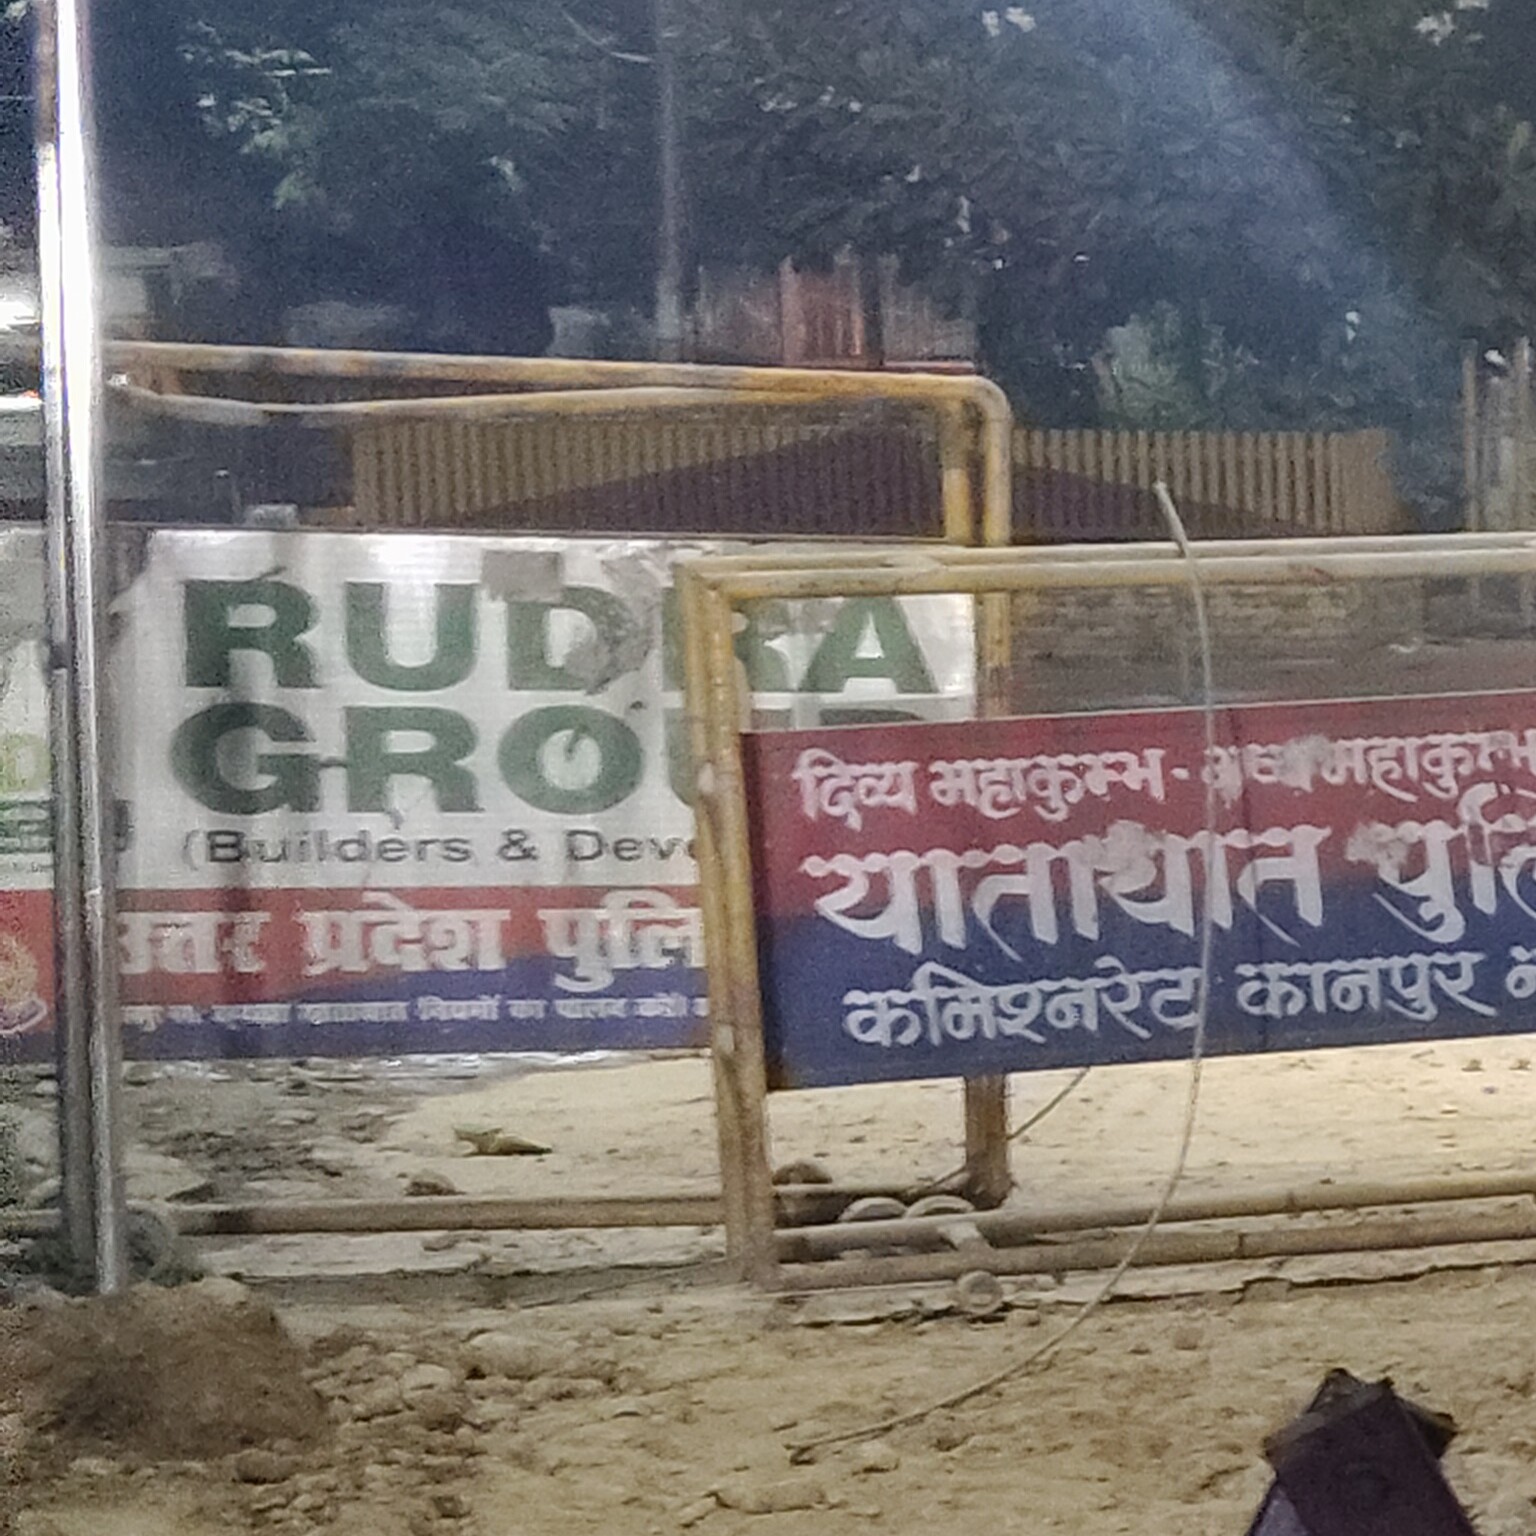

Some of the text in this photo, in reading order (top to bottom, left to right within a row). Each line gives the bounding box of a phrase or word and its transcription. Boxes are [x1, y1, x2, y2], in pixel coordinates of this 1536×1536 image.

[170, 701, 703, 816] GRO
[792, 748, 919, 832] दिव्य
[928, 748, 1166, 822] महाकुम्भ
[498, 829, 539, 860] &
[800, 820, 1332, 962] यातायात
[292, 891, 511, 977] प्रदेश
[536, 889, 706, 993] पुलि
[842, 955, 1205, 1048] कमिश्नरेट
[1234, 950, 1498, 1024] कानपुर
